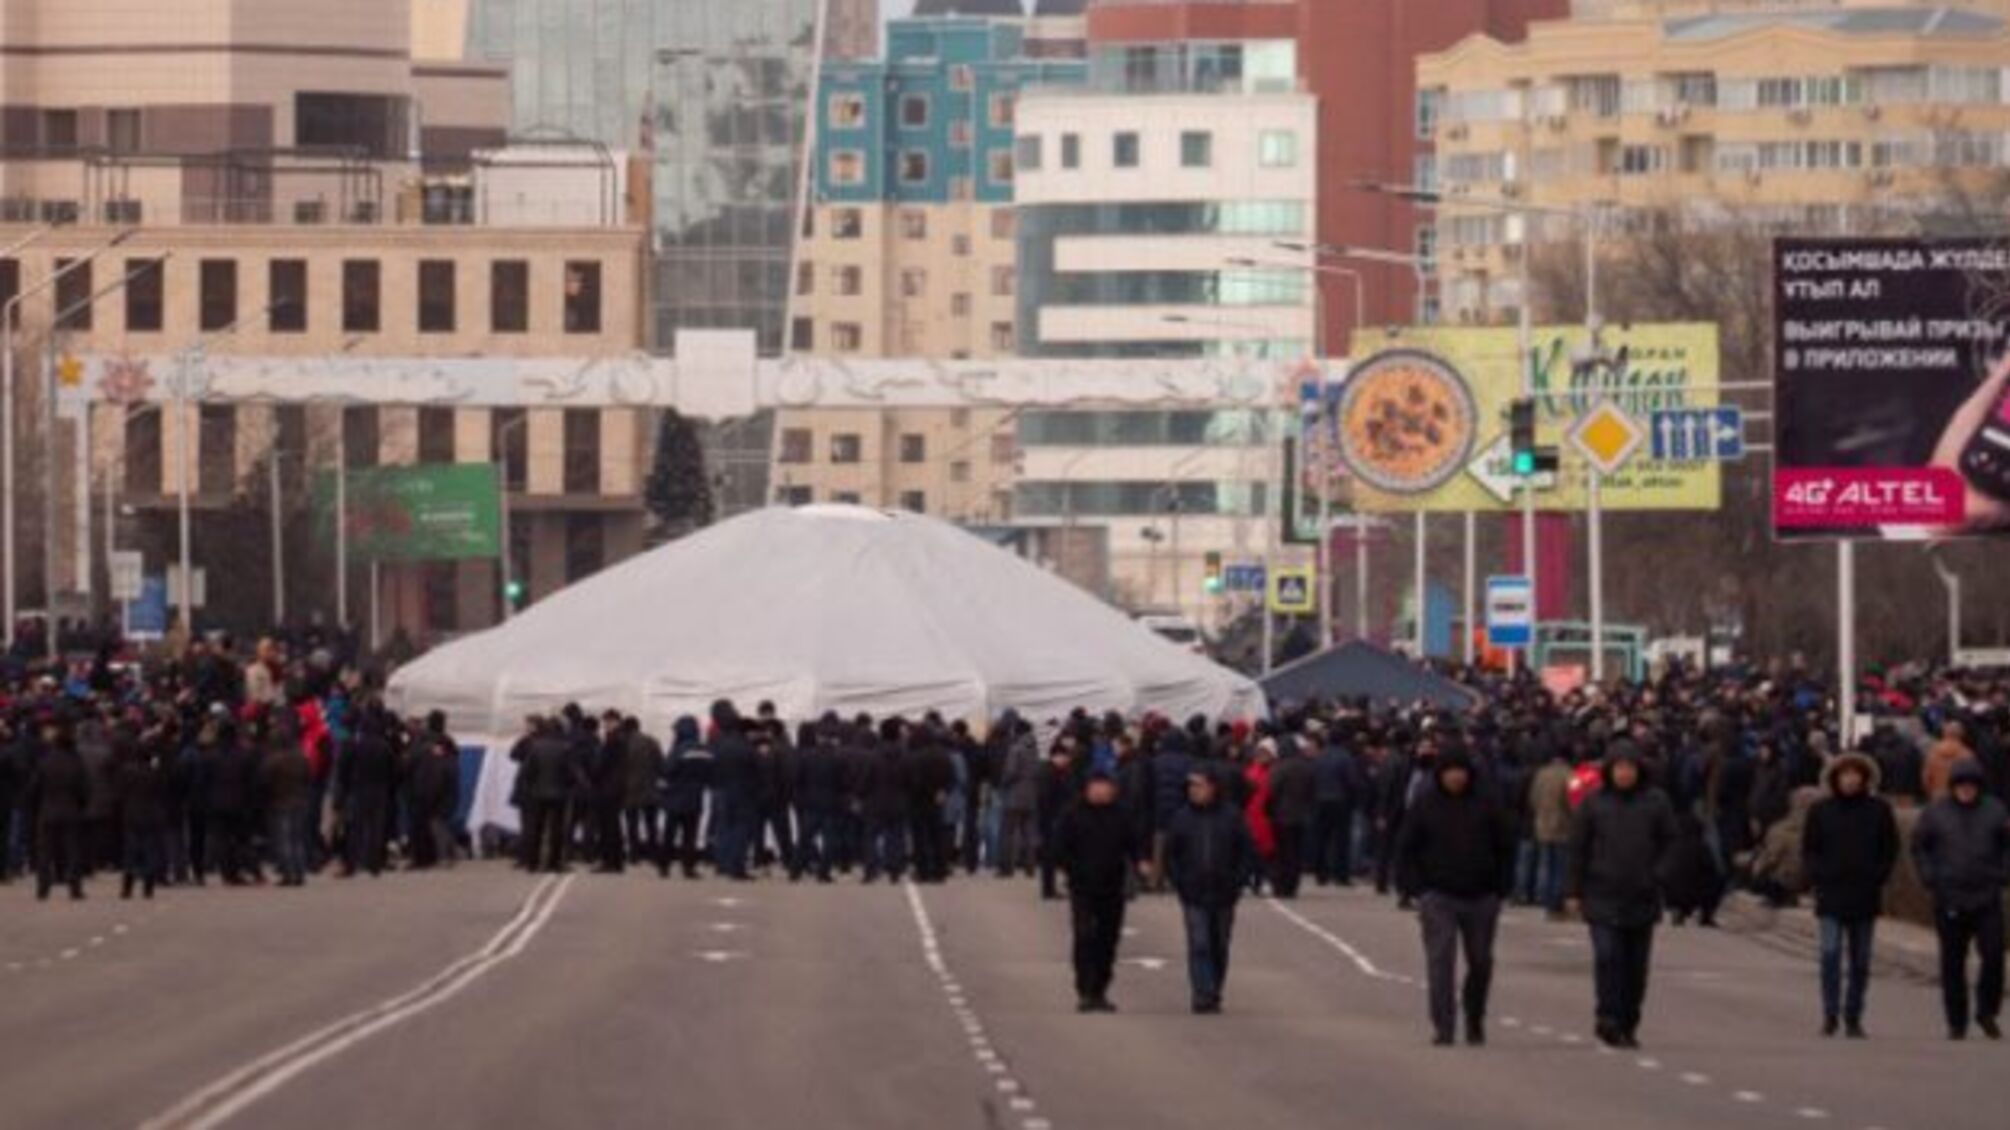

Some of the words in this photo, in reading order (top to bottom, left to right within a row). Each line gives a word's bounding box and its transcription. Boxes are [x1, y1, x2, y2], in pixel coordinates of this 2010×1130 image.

[1784, 250, 1924, 272] ҚОСЫМШАДА
[1850, 279, 1880, 298] АЛ
[1784, 315, 1922, 340] ВЫИГРЫВАЙ
[1927, 320, 2005, 340] ПРИЗЫ
[1784, 349, 1799, 369] В
[1804, 348, 1957, 369] ПРИЛОЖЕНИИ
[1836, 480, 1945, 504] ALTEL
